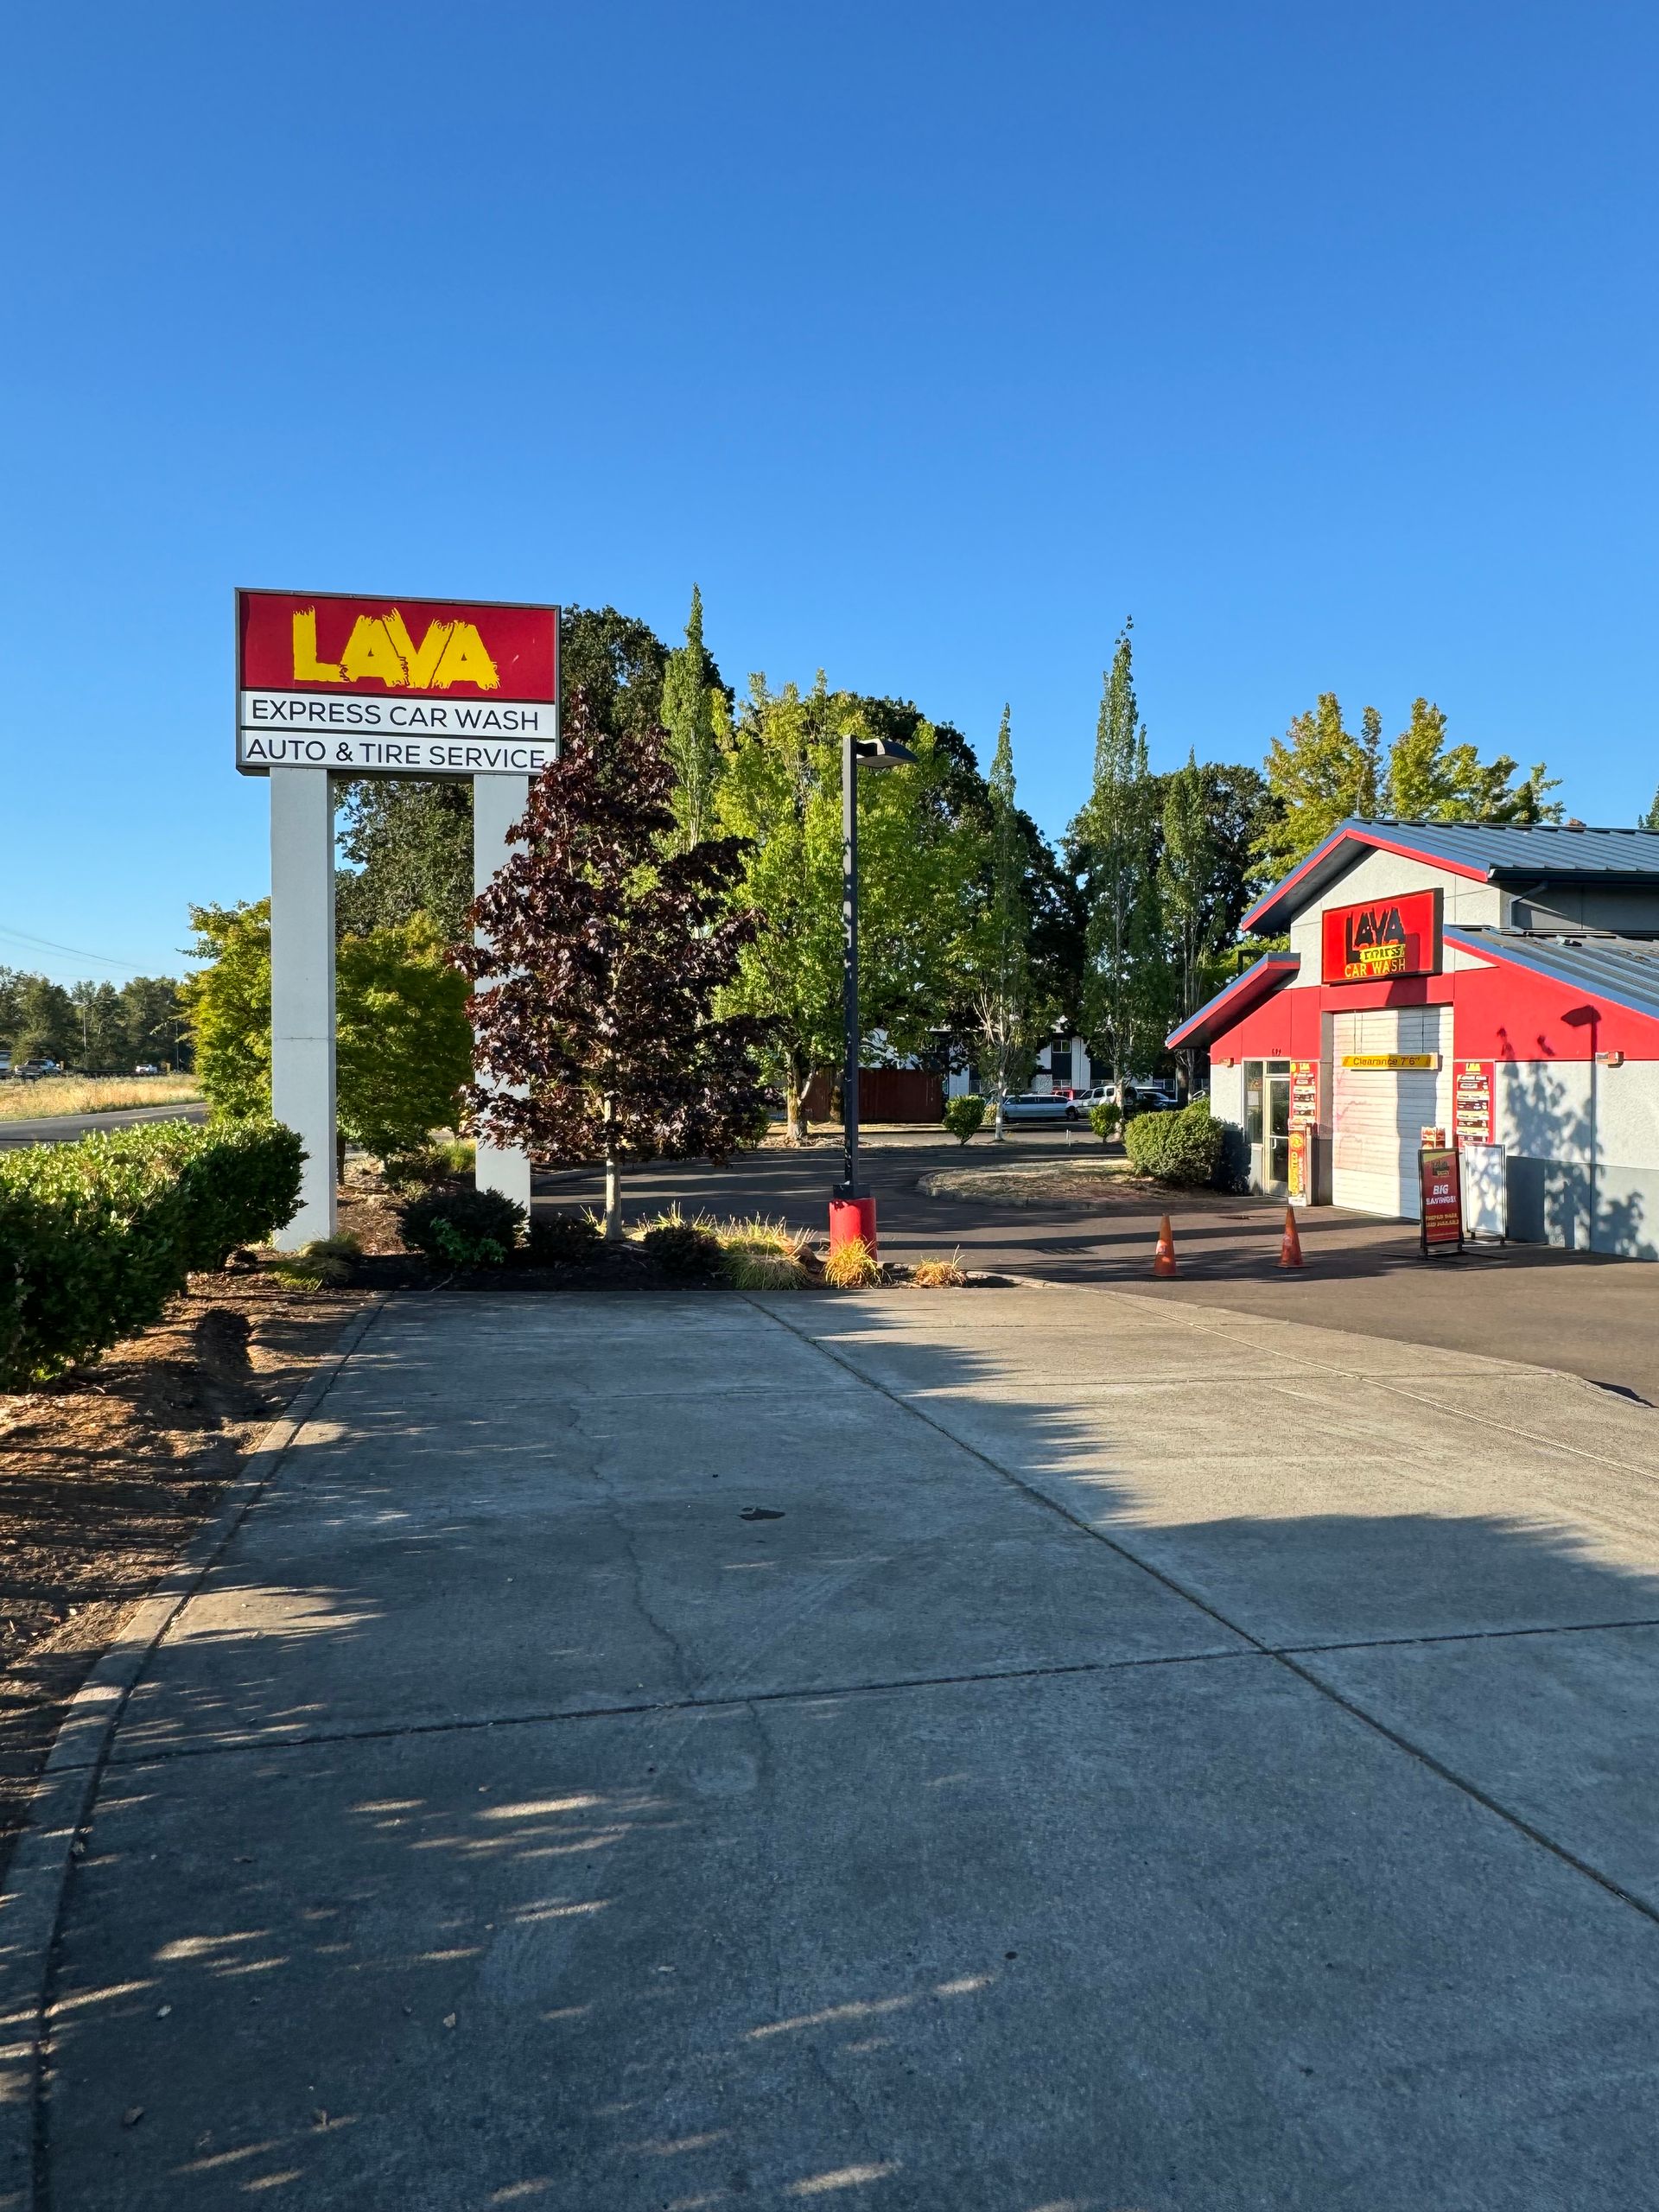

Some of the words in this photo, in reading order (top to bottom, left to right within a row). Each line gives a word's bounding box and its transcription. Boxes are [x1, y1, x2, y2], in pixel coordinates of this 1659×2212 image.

[292, 605, 501, 690] LAVA
[252, 699, 381, 724] EXPRESS
[390, 706, 448, 728] CAR
[454, 709, 538, 731] WASH
[246, 739, 326, 760] AUTO
[336, 742, 353, 762] &
[359, 743, 421, 765] TIRE
[429, 746, 545, 769] SERVICE
[1345, 905, 1406, 963] LAVA
[1363, 945, 1405, 960] EXPRESS
[1344, 963, 1368, 978] CAR
[1371, 958, 1406, 975] WASH
[1353, 1057, 1398, 1065] Clearance
[1433, 1184, 1449, 1195] BIG
